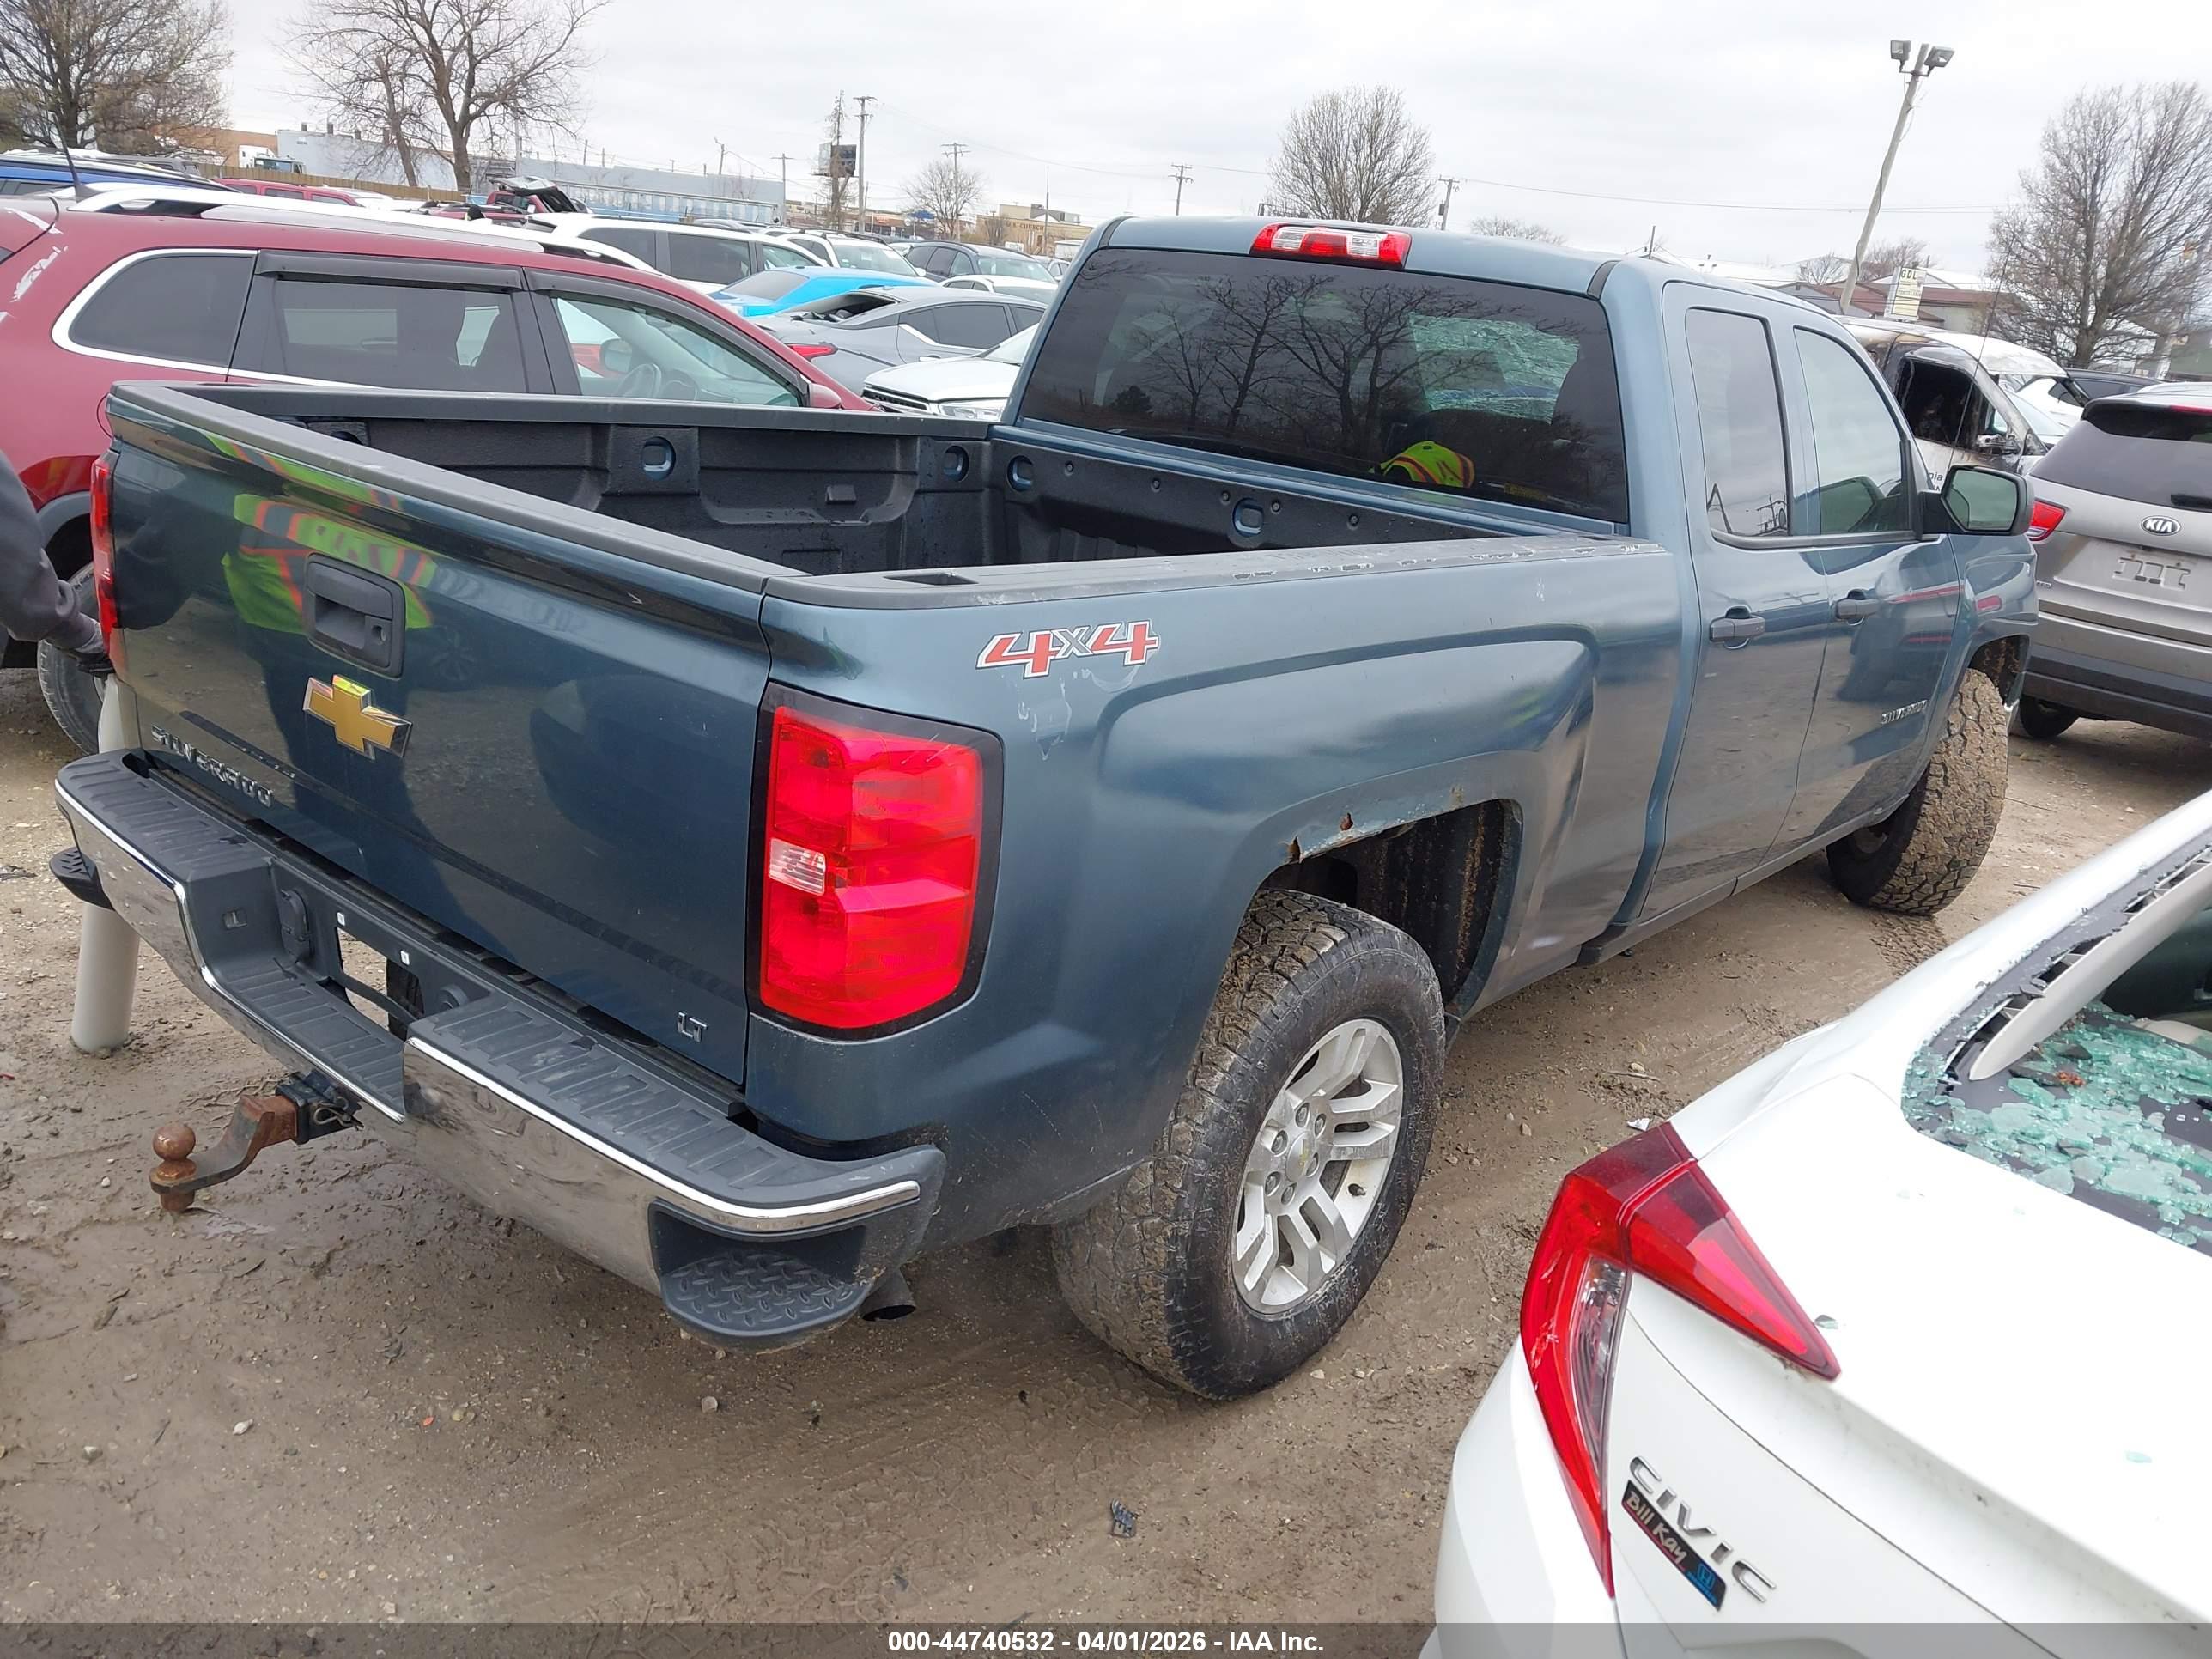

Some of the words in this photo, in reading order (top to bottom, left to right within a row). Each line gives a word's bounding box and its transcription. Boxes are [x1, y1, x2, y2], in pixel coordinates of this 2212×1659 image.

[2145, 518, 2173, 533] KIA
[677, 1011, 708, 1043] LT
[1626, 1490, 1656, 1526] Bill
[1652, 1522, 1688, 1565] Kay
[1629, 1455, 1778, 1604] CIVIC
